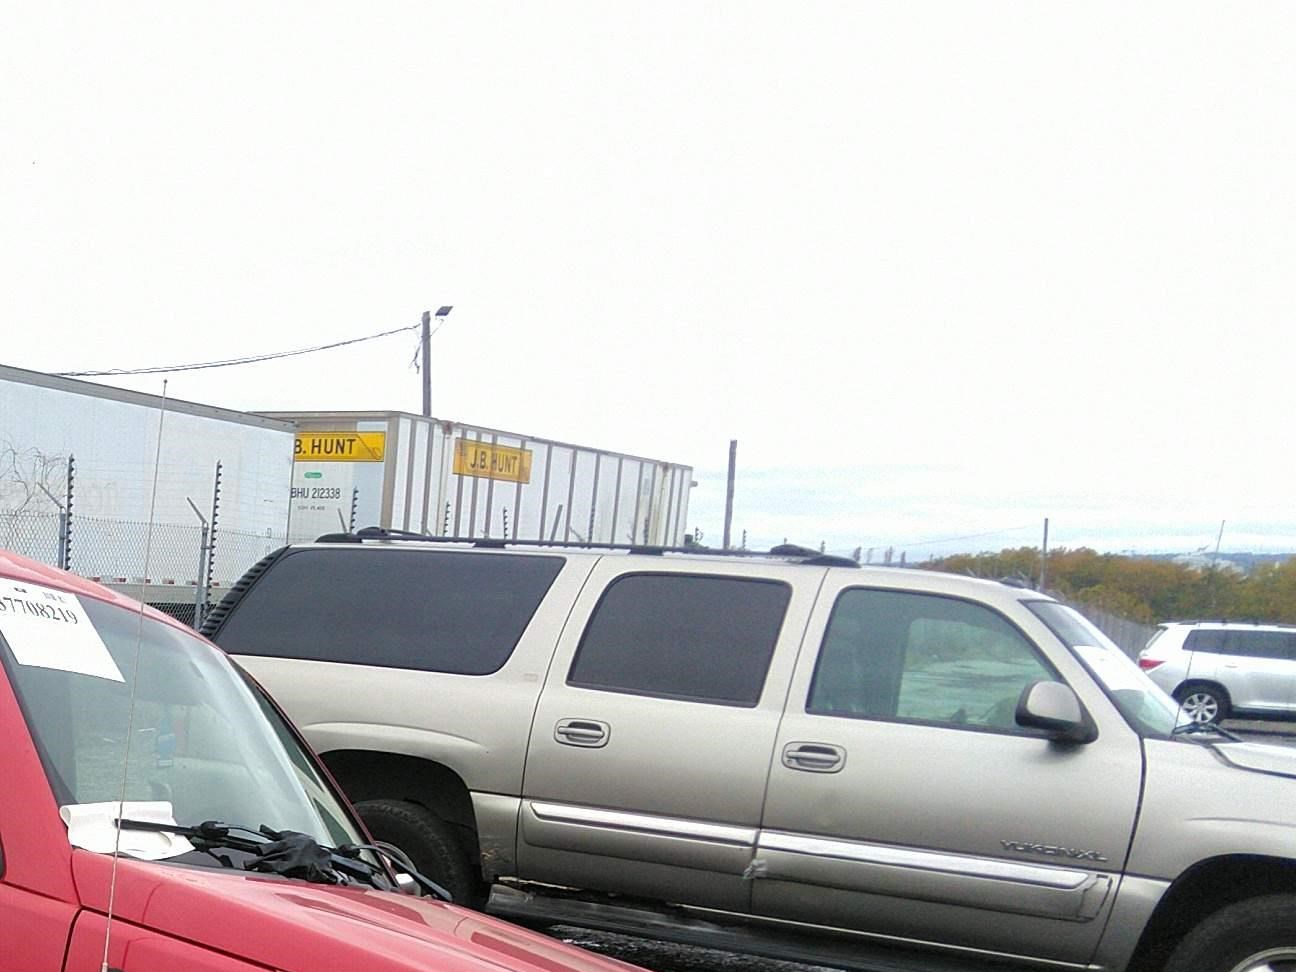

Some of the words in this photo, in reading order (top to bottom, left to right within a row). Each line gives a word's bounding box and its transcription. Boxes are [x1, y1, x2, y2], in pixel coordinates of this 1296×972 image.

[311, 438, 356, 454] HUNT
[491, 452, 517, 473] HUNT
[312, 487, 341, 500] 212338
